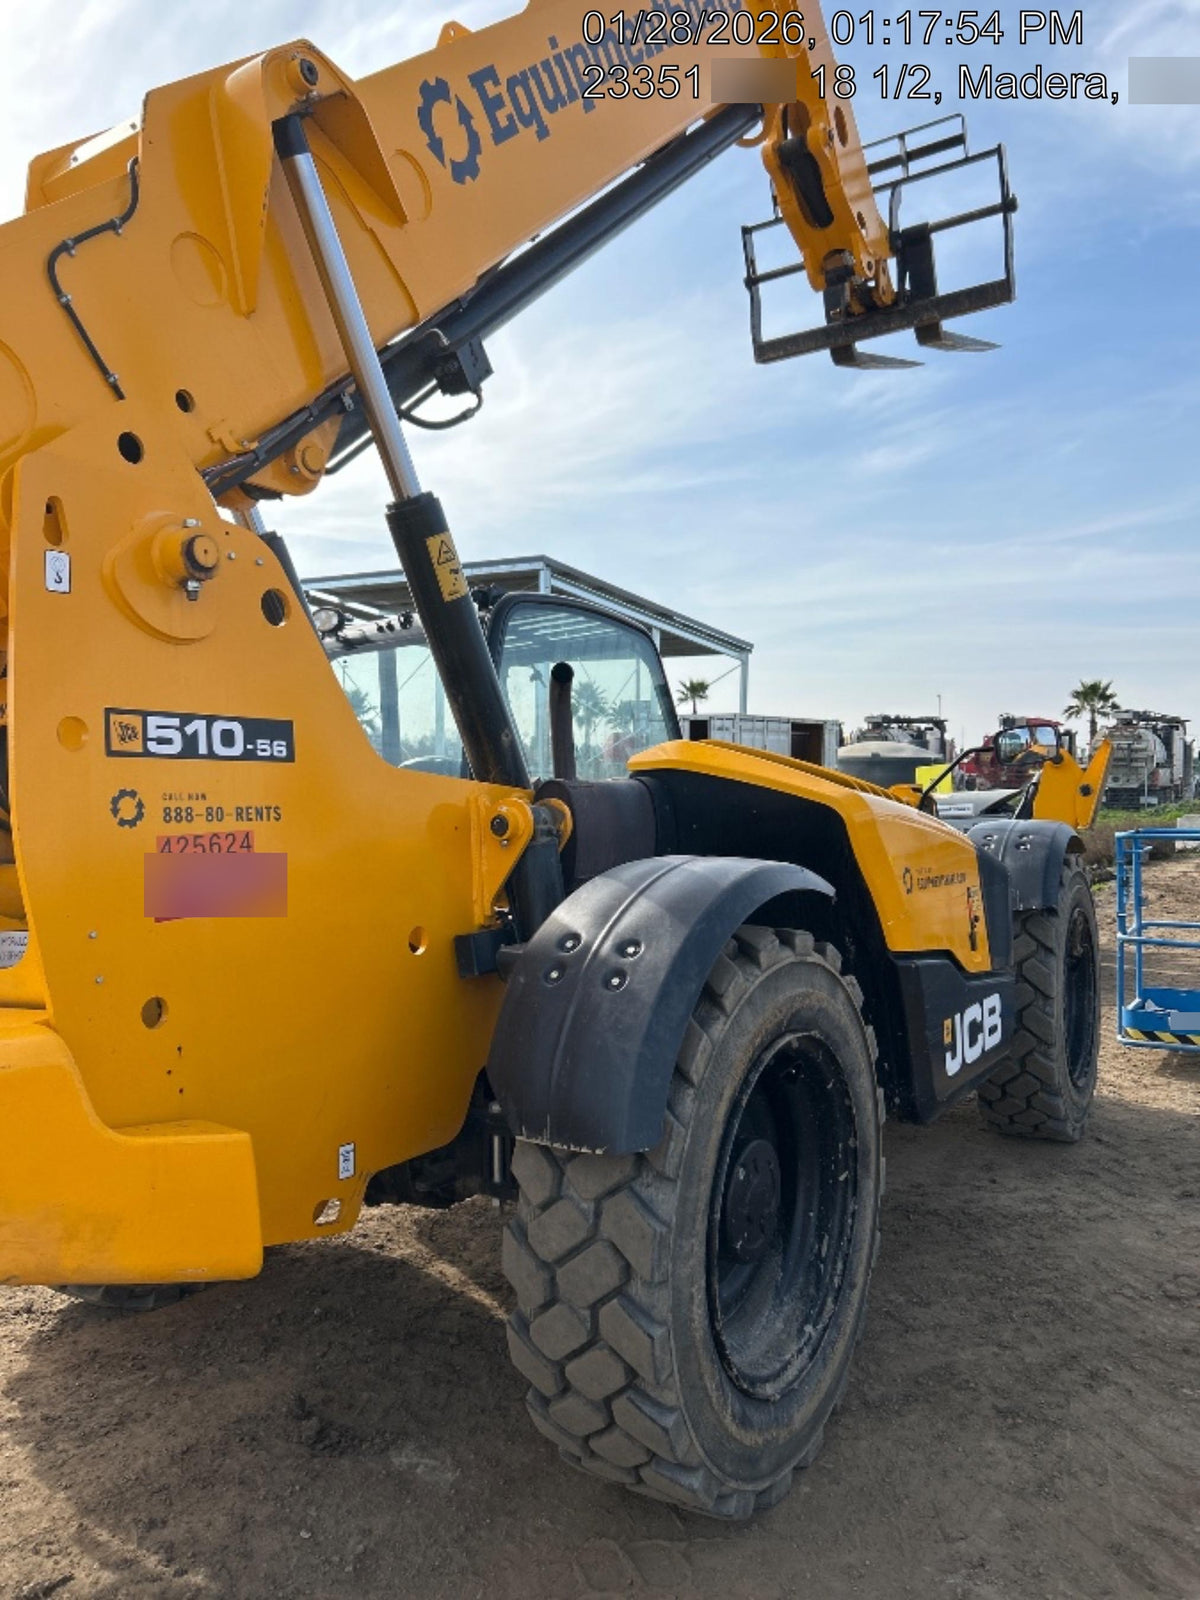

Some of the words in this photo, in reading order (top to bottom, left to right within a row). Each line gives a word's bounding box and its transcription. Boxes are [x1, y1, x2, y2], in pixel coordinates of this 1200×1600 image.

[162, 805, 282, 823] 888-80-RENTS
[160, 831, 253, 853] 425624
[945, 992, 1002, 1077] JCB
